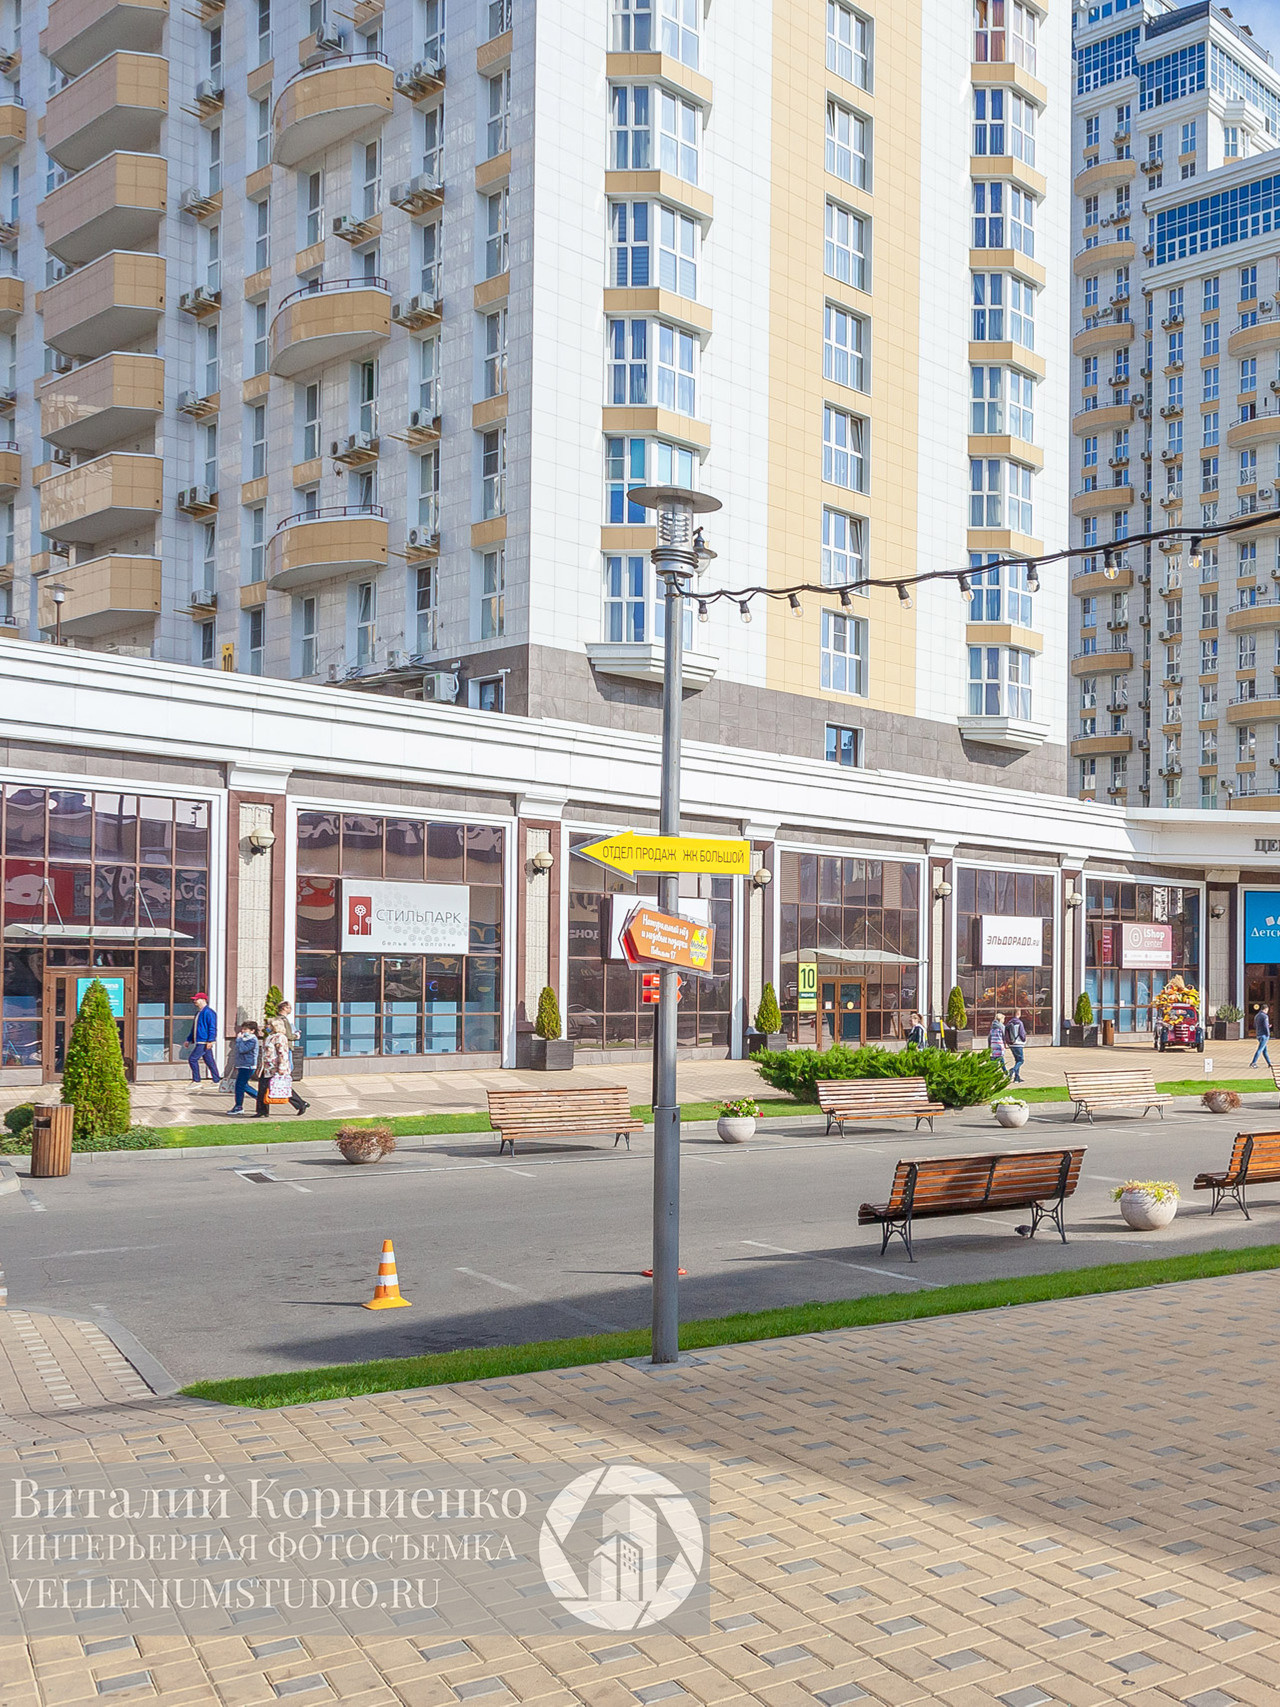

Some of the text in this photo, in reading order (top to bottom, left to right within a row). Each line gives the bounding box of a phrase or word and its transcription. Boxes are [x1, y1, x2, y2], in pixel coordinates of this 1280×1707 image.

[602, 845, 744, 864] ОТДЕЛ ПРОДАЖ ЖК БОЛЬШОЙ
[376, 909, 461, 923] СТИЛЬПАРК
[800, 968, 815, 989] 10
